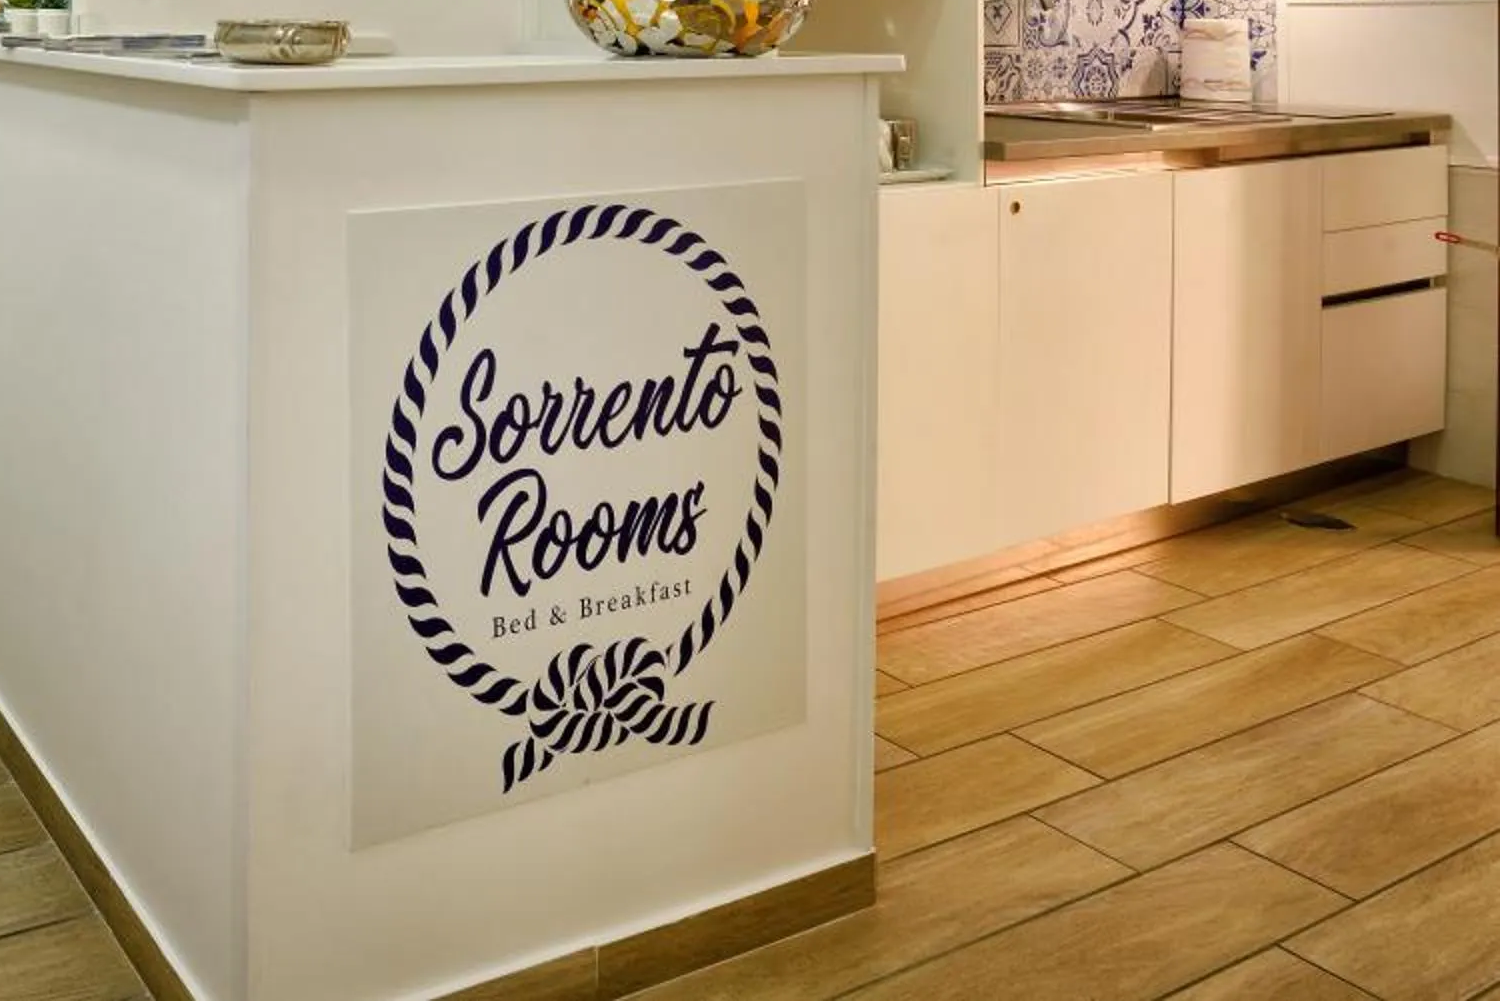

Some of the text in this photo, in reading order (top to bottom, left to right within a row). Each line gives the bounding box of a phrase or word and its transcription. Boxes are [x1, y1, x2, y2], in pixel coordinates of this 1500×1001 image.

[431, 322, 743, 481] Sorrento
[477, 468, 708, 597] Rooms
[492, 578, 693, 639] Bed & Breakfast
